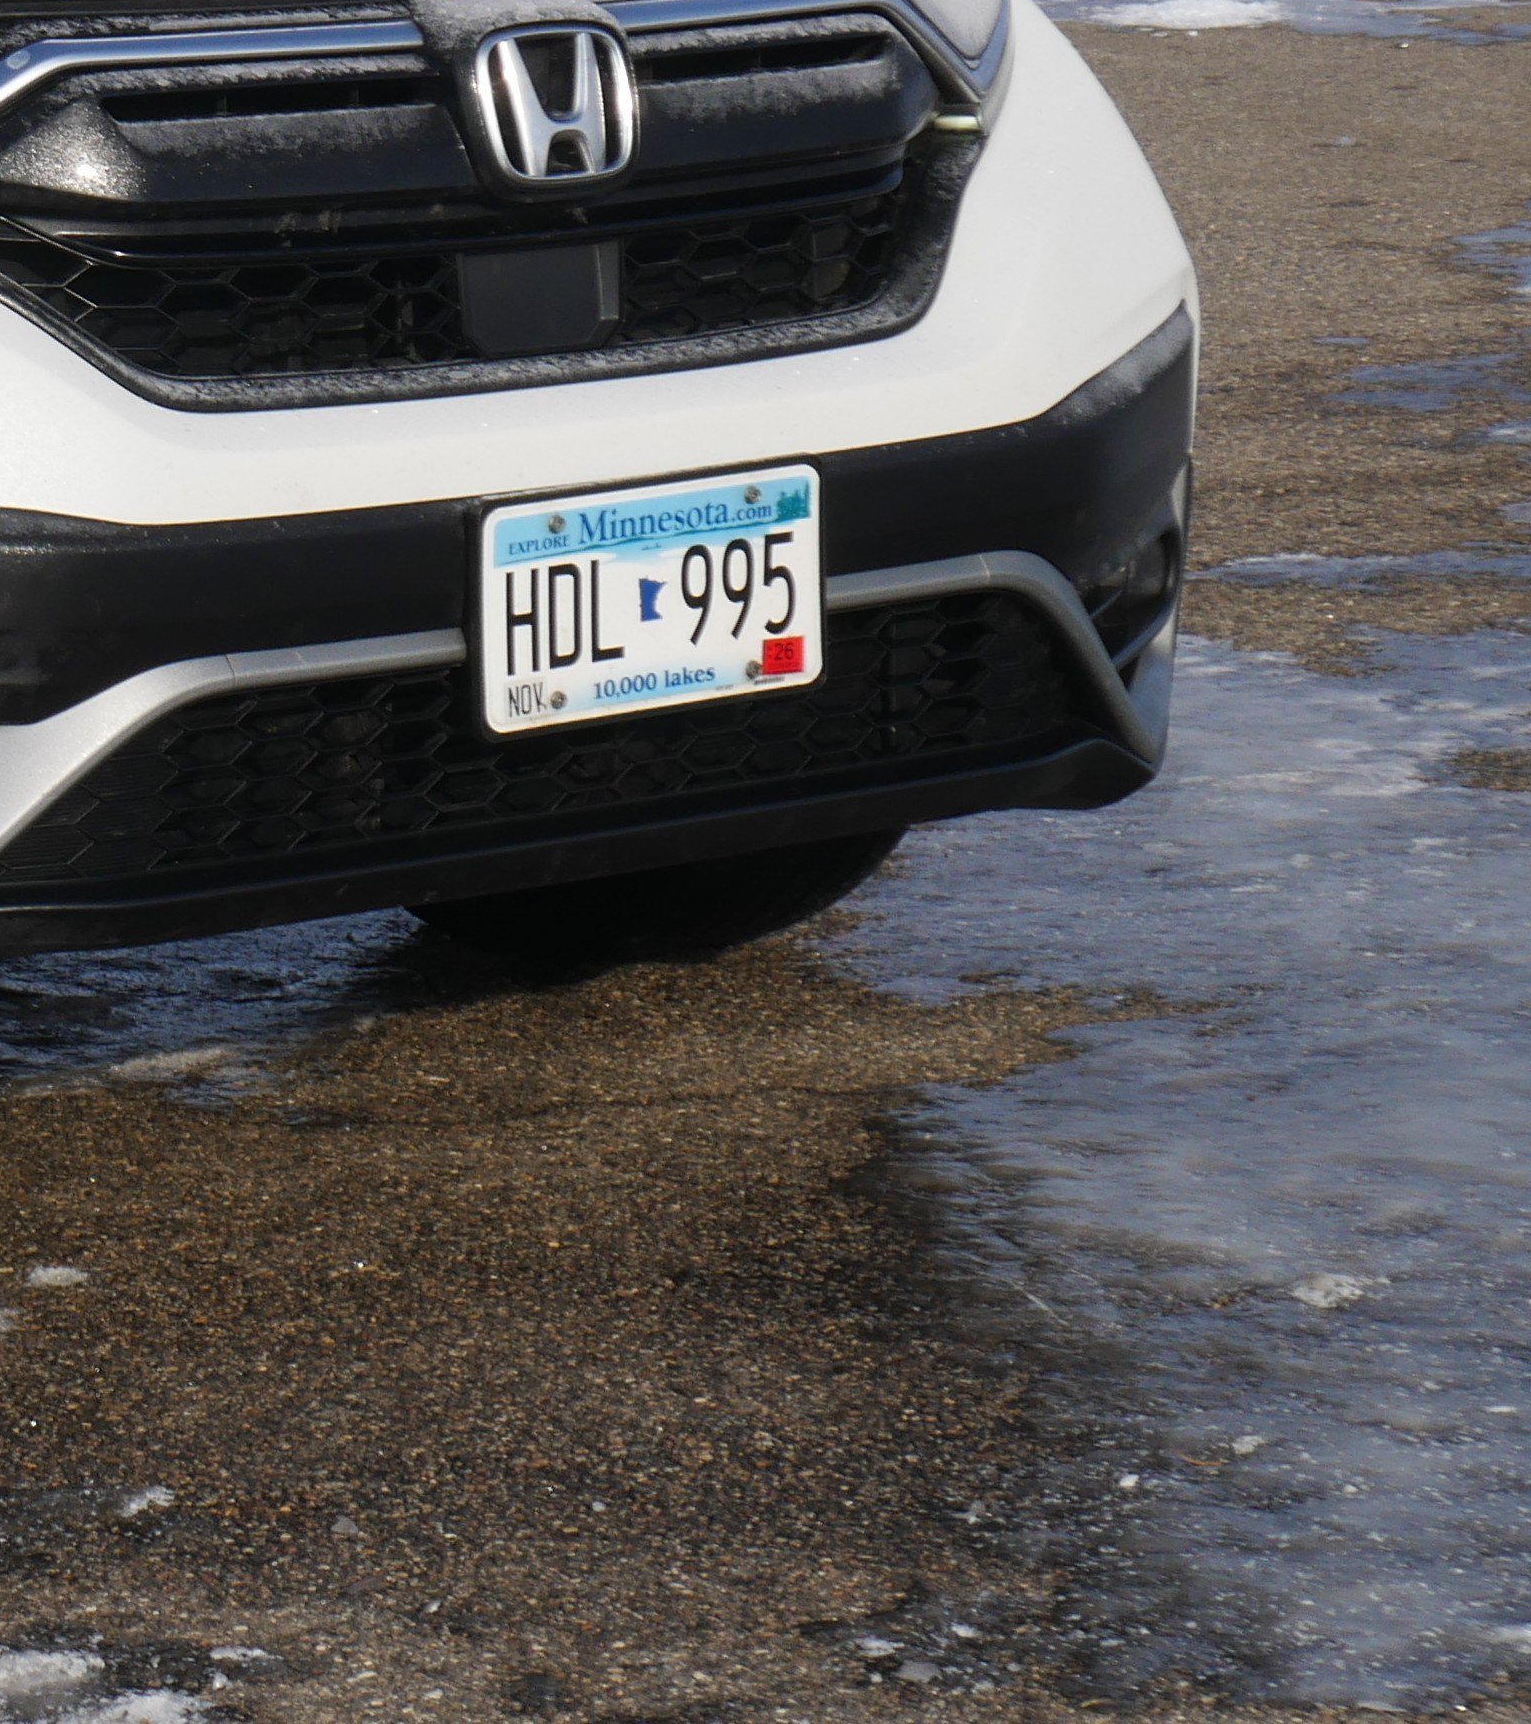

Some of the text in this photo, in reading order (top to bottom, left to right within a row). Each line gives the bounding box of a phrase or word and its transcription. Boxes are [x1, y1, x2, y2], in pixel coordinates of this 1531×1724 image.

[508, 502, 772, 556] EXPLORE Minnesota.com
[506, 532, 795, 675] HDL 995
[774, 642, 794, 661] 26
[508, 682, 547, 718] NOV
[592, 667, 716, 702] 10,000 lakes
